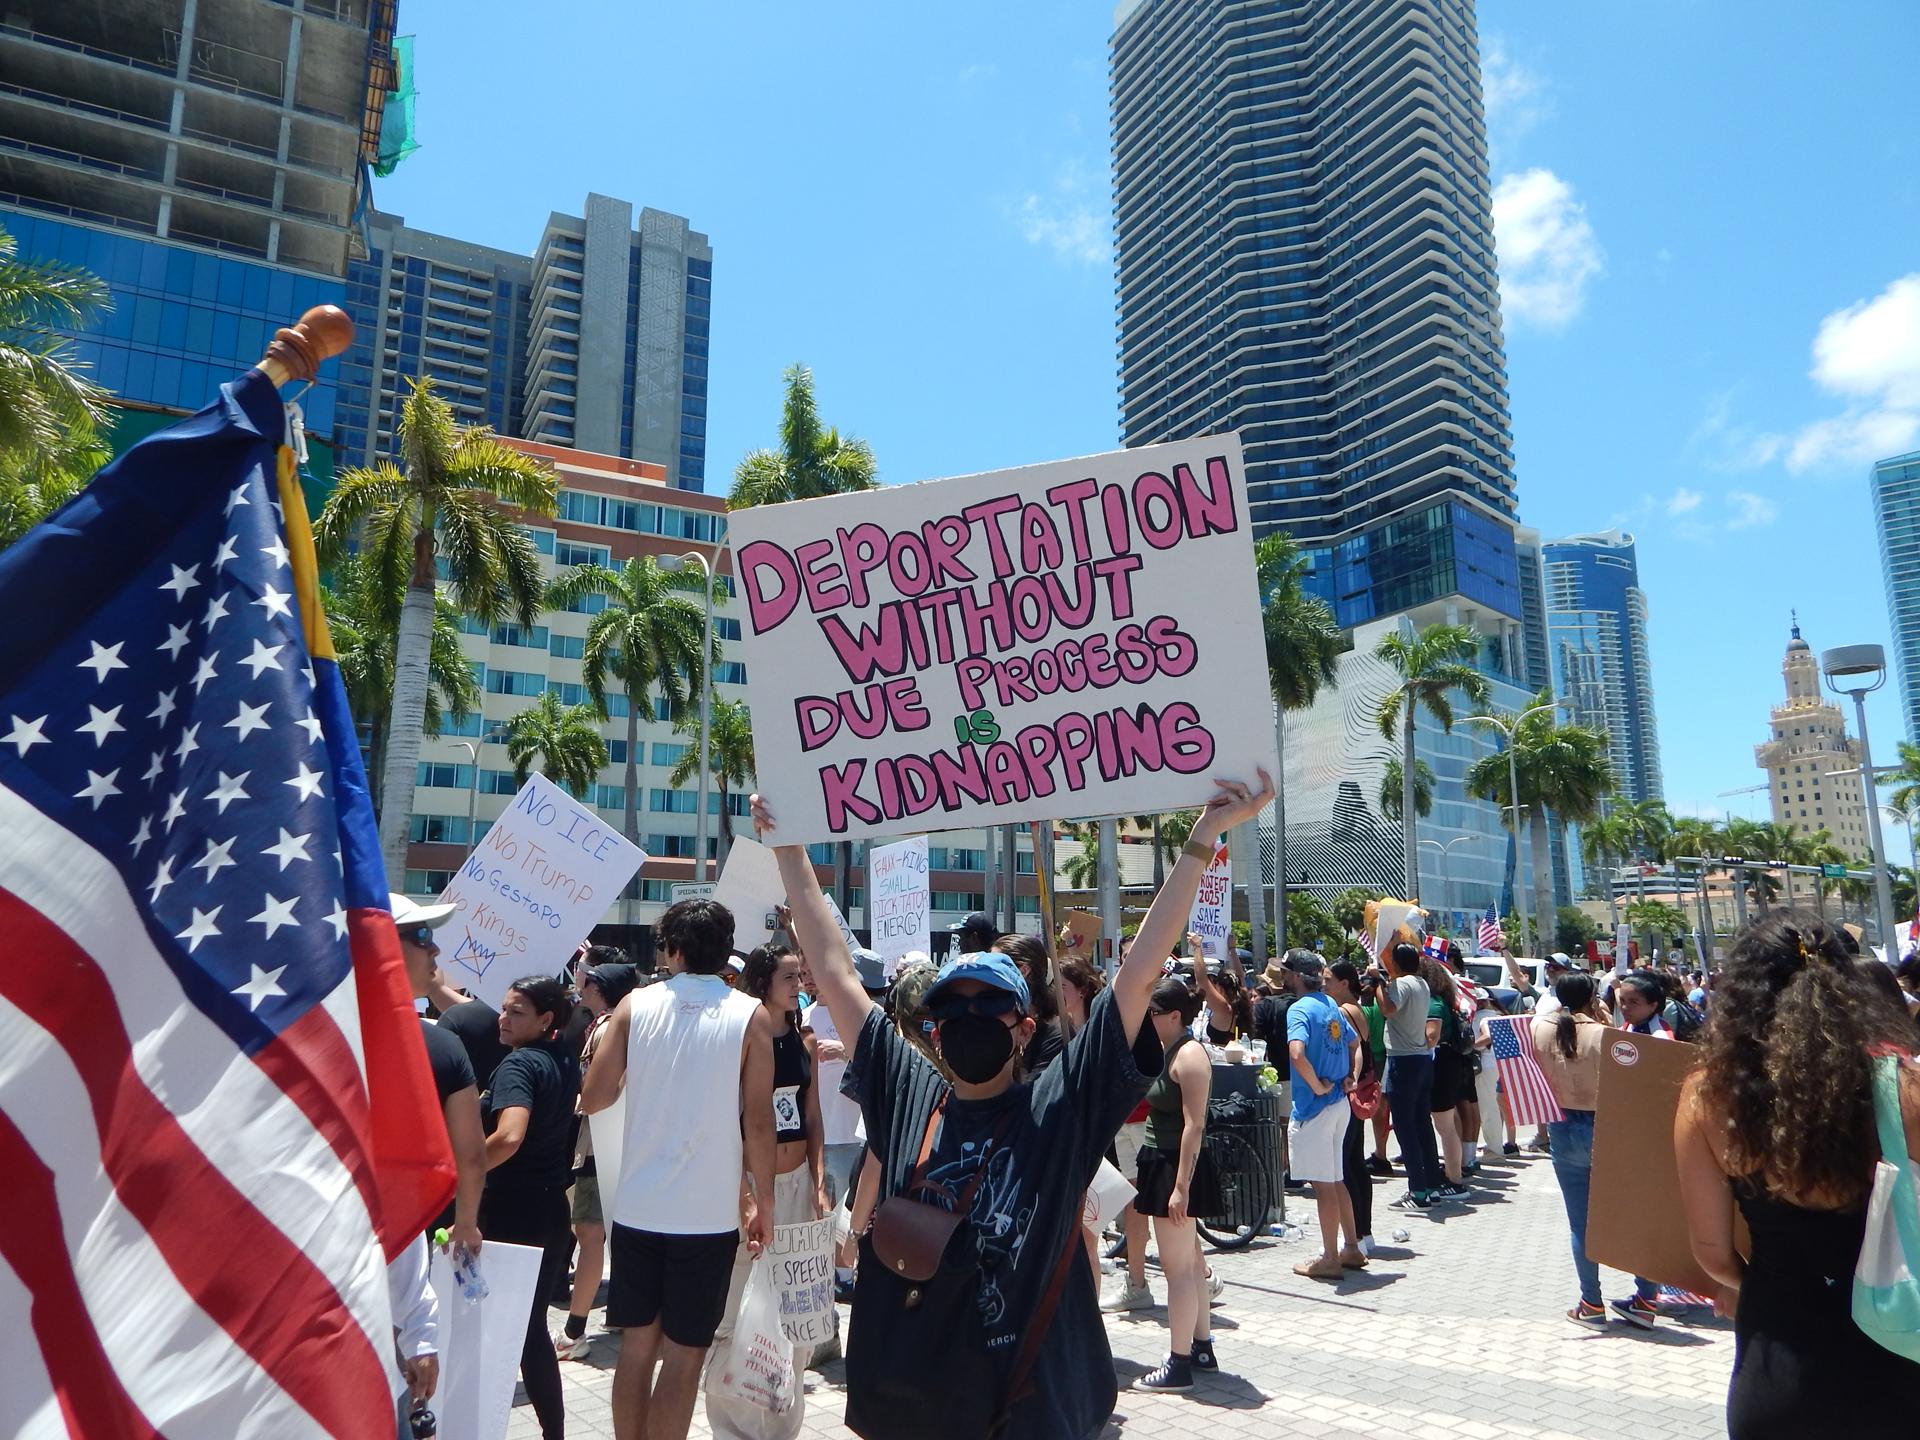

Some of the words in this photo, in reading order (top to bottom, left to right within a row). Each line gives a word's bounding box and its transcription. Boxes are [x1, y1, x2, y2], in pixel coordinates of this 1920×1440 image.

[737, 455, 1238, 635] DEPORTATION
[818, 553, 1143, 684] WITHOUT
[795, 678, 931, 752] DUE
[954, 615, 1199, 711] PROCESS
[954, 709, 1001, 745] IS
[819, 701, 1215, 833] KIDNAPPING
[517, 785, 556, 827] NO
[557, 809, 619, 862] ICE
[880, 874, 920, 897] SMALL
[1198, 889, 1225, 908] 2025!
[1200, 874, 1230, 893] ROJECT
[877, 910, 925, 941] ENERGY
[1192, 920, 1228, 939] DEMOCRACY
[1197, 907, 1220, 924] SAVE
[1615, 1046, 1635, 1058] TRUMP
[784, 1253, 829, 1286] SPEECH
